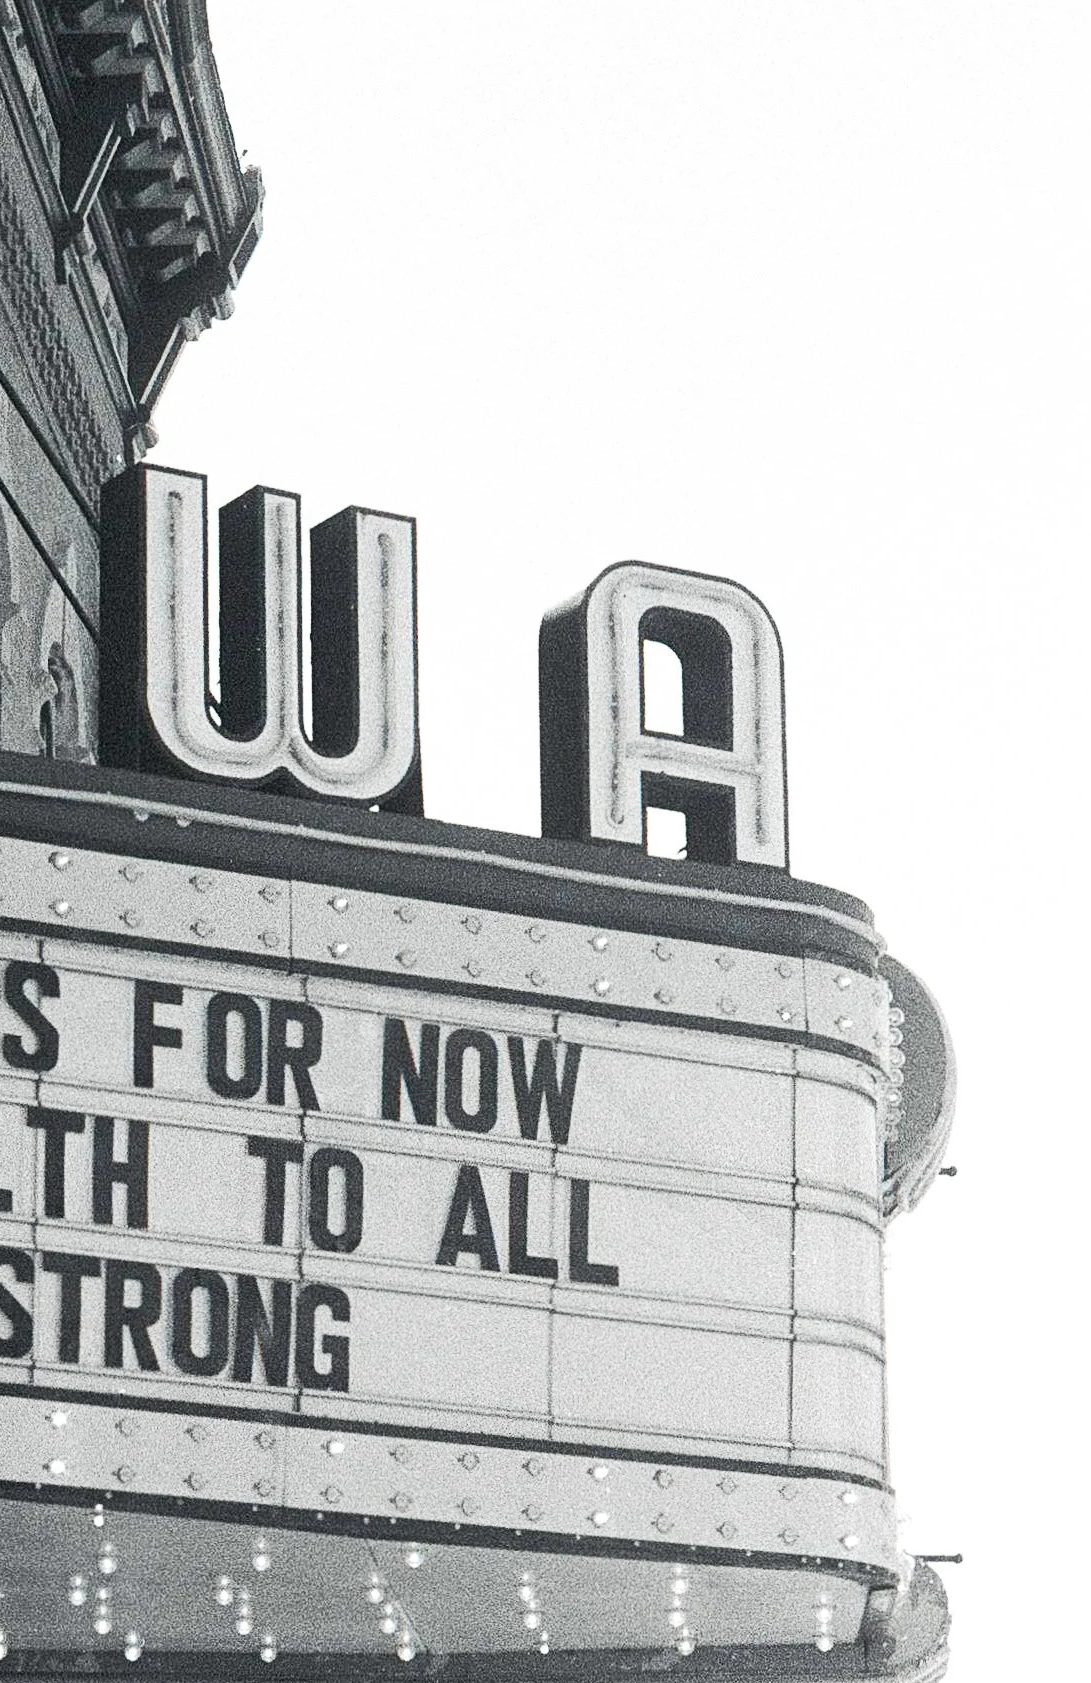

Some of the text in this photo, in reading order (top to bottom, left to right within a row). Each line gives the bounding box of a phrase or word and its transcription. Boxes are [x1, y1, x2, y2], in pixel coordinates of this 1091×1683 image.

[133, 980, 323, 1111] FOR
[380, 1018, 583, 1145] NOW
[247, 1136, 364, 1253] TO
[435, 1164, 619, 1287] ALL
